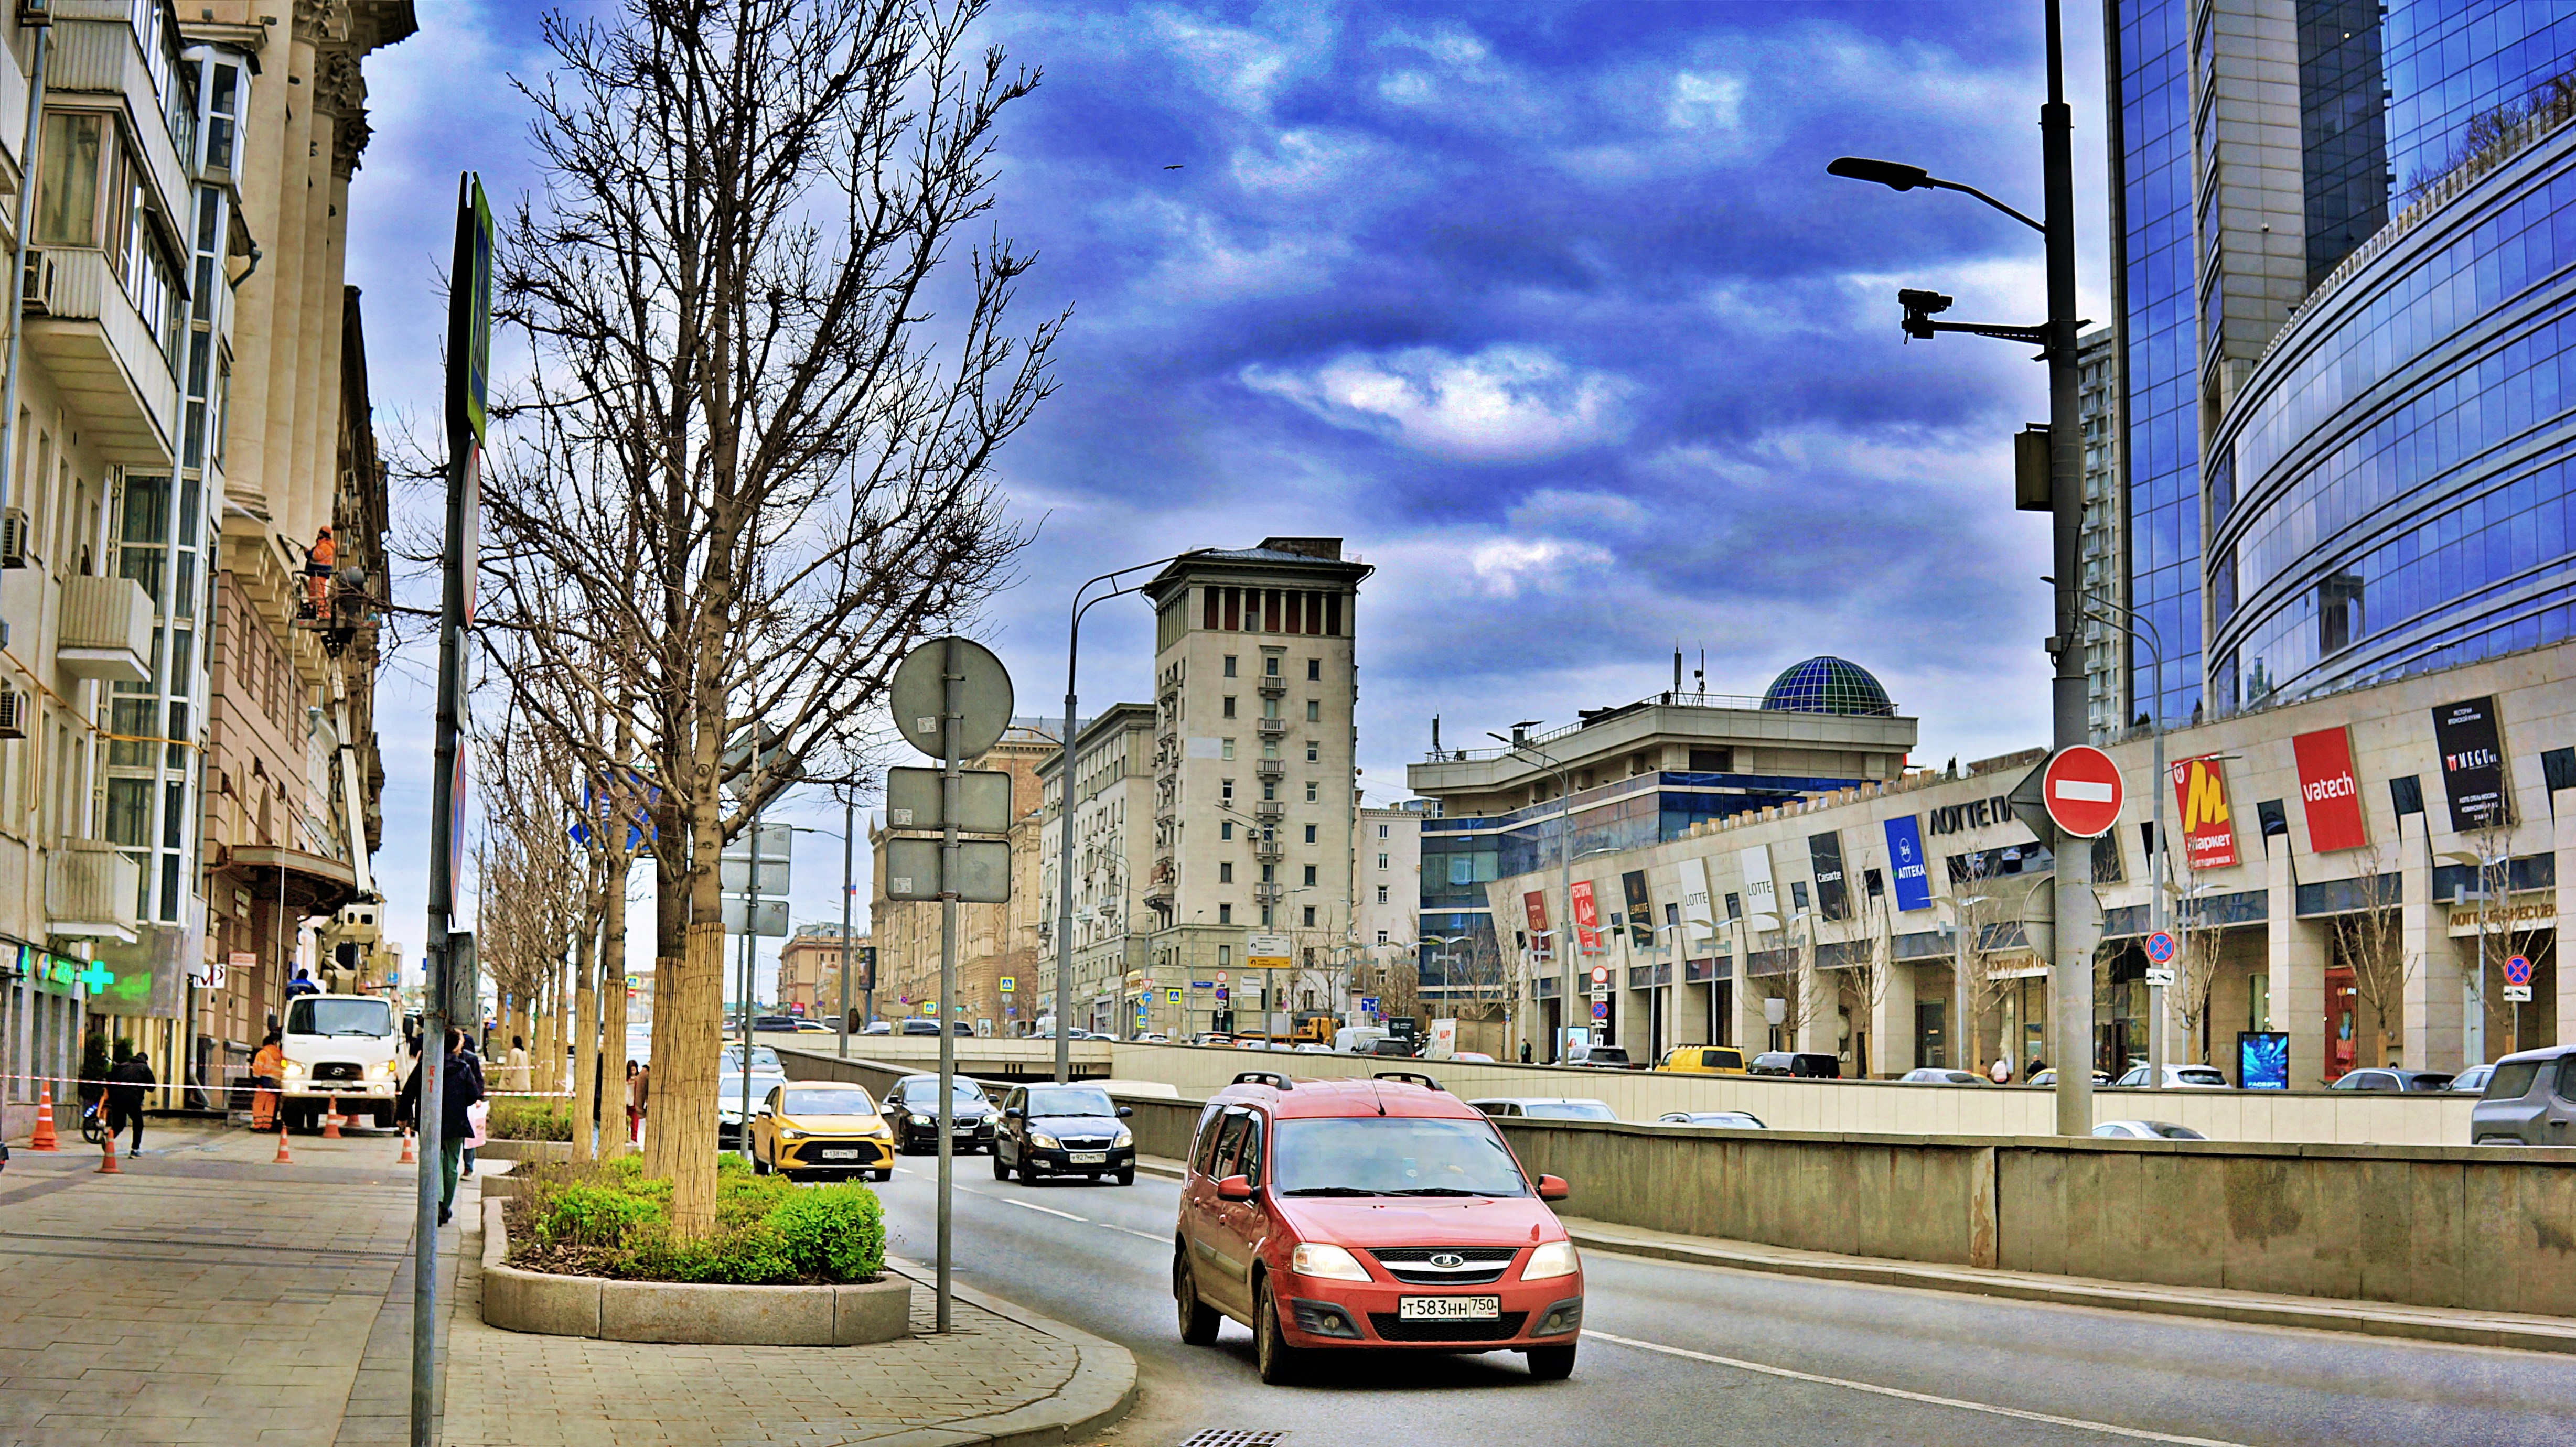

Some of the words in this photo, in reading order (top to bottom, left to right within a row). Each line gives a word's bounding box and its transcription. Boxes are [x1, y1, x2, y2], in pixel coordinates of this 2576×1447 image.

[2303, 770, 2355, 802] vatech
[1930, 799, 1990, 836] ЛОТТЕ
[1817, 871, 1842, 883] Casarte
[1898, 863, 1926, 879] АПТЕКА
[1747, 881, 1773, 896] LOTTE
[1685, 892, 1708, 906] LOTTE
[1407, 1300, 1467, 1315] Т583НН
[1471, 1299, 1494, 1310] 750
